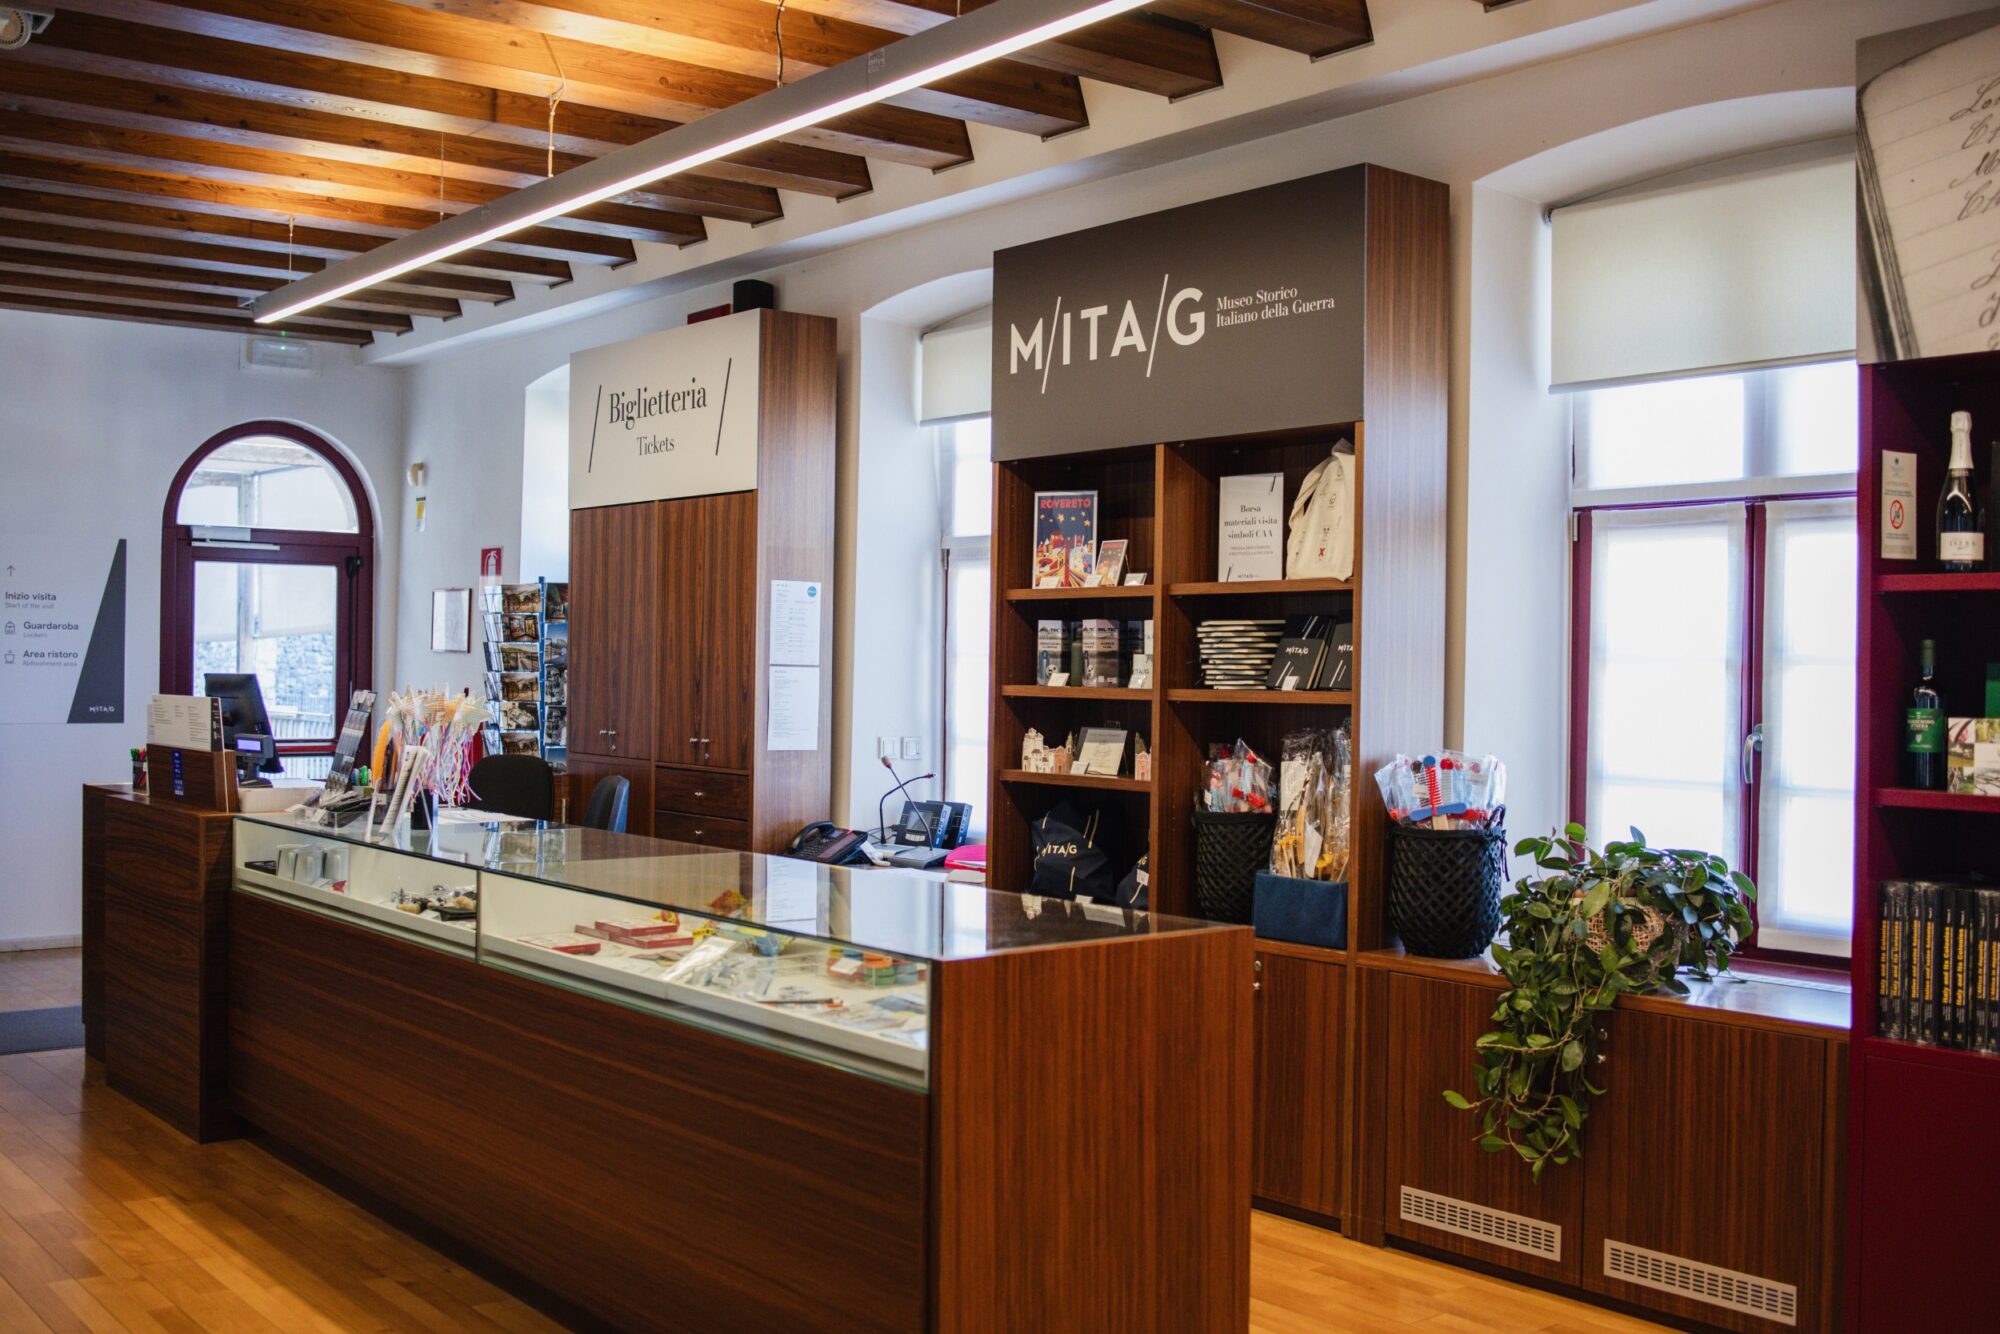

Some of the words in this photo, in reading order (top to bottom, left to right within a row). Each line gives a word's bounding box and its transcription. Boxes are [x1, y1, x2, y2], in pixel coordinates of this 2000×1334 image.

[1216, 296, 1253, 311] Museo
[1255, 286, 1298, 304] Storico
[1216, 311, 1258, 327] Italiano
[1261, 305, 1289, 320] della
[1292, 297, 1335, 314] Guerra
[608, 377, 707, 430] Biglietteria
[636, 434, 675, 456] Tickets
[1040, 498, 1091, 509] ROVERETO
[1240, 504, 1261, 512] Borsa
[5, 592, 30, 600] Inizio
[32, 592, 57, 601] visita
[23, 620, 79, 630] Guardaroba
[23, 649, 45, 658] Area
[47, 650, 79, 659] ristoro
